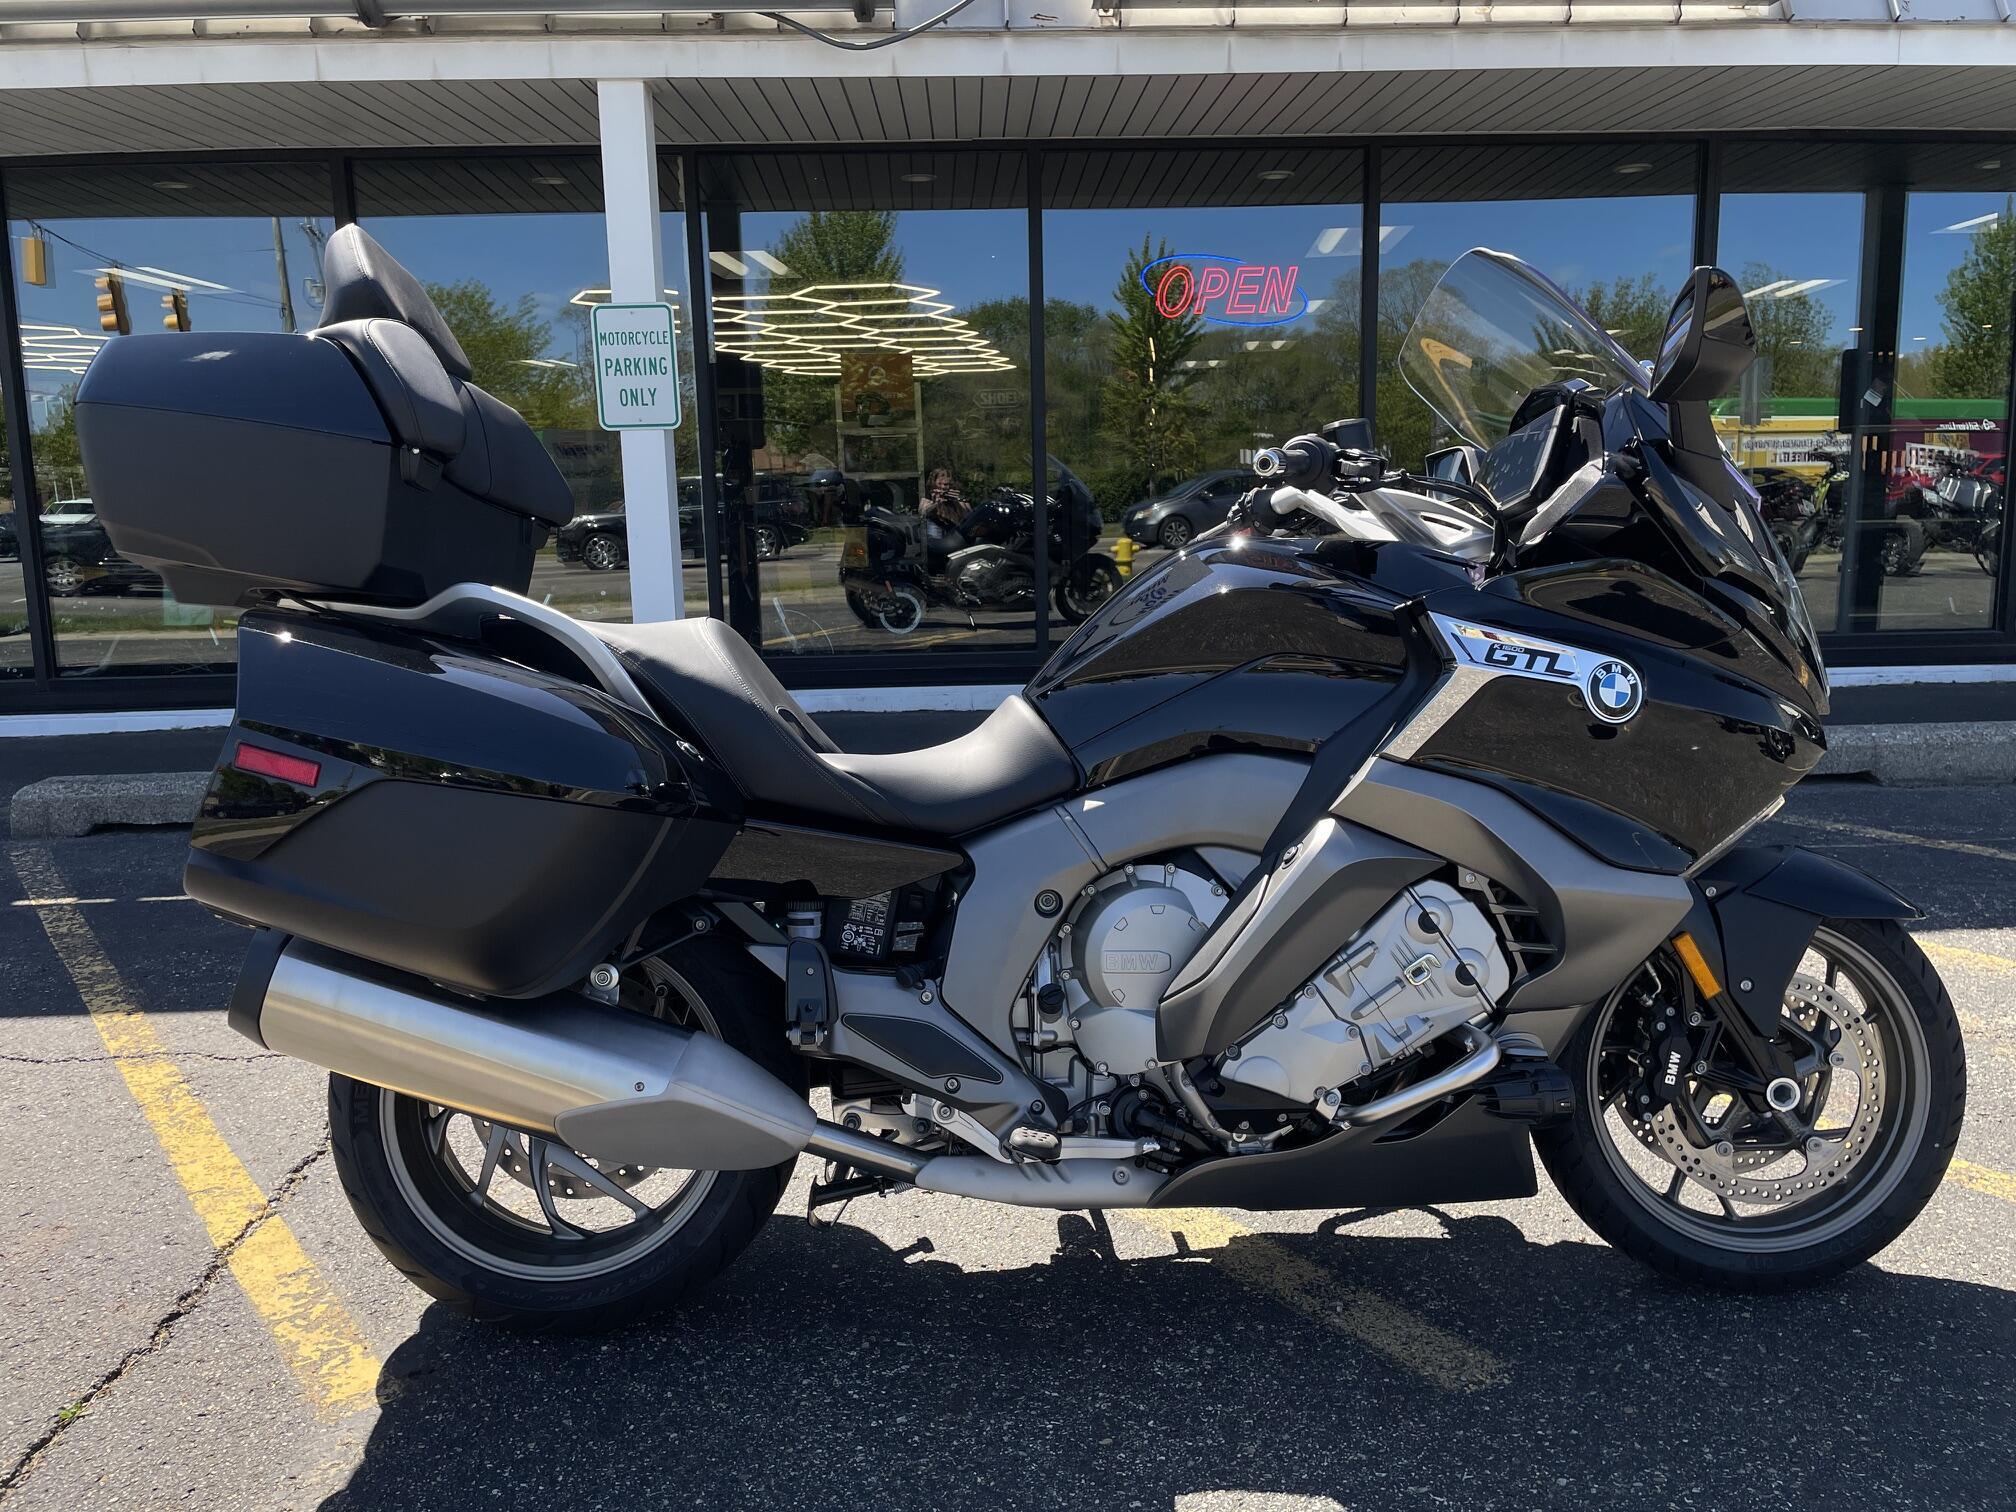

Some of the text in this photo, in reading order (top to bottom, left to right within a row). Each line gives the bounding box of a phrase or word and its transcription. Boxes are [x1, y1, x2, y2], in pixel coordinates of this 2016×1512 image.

[1156, 265, 1298, 318] OPEN
[599, 331, 669, 346] MOTORCYCLE
[605, 357, 668, 377] PARKING
[619, 387, 657, 407] ONLY
[1502, 645, 1525, 653] 1600
[1484, 643, 1575, 677] GTL
[1595, 664, 1636, 685] BMW
[1105, 953, 1159, 971] BMW
[1664, 1050, 1681, 1086] BMW
